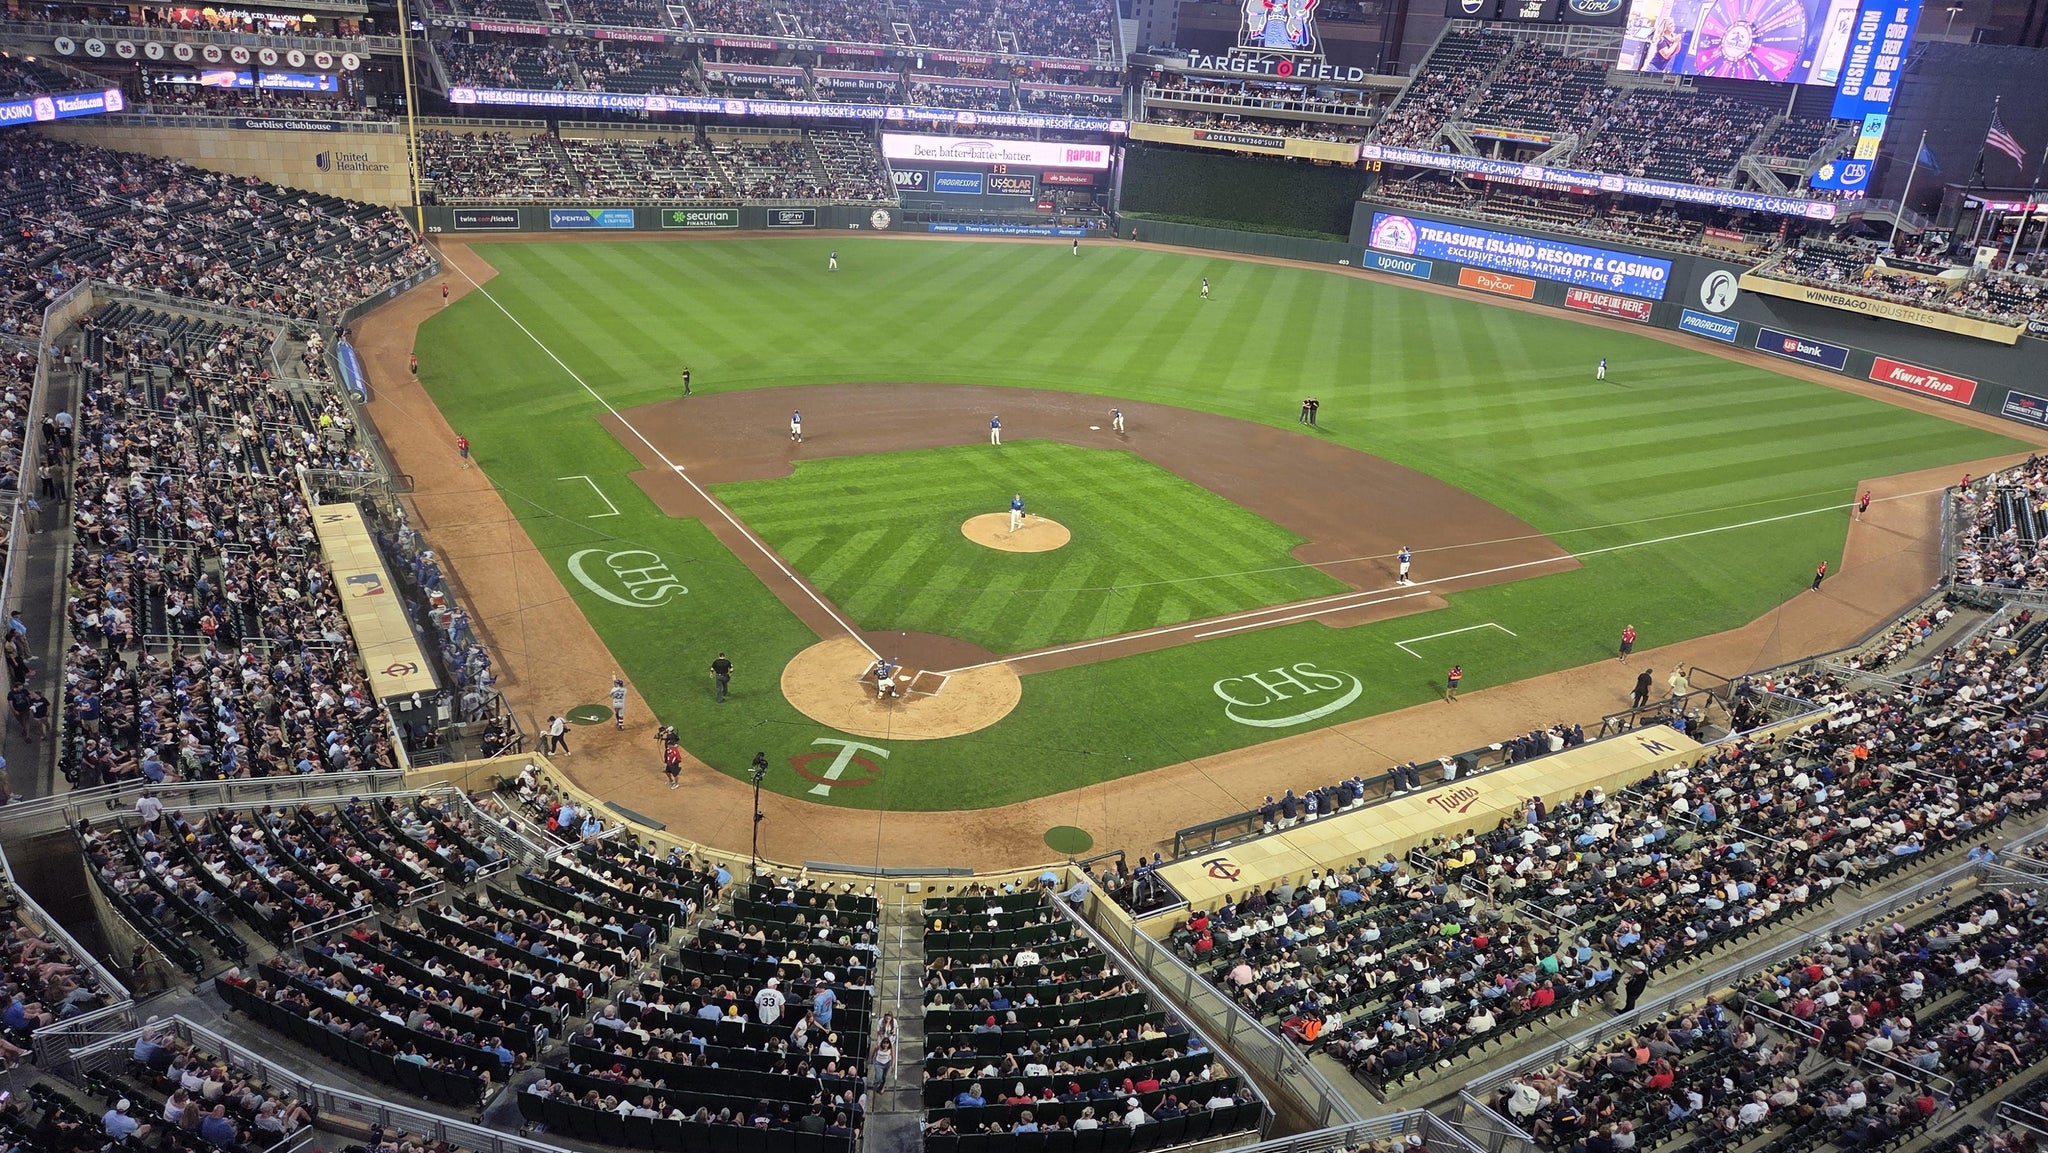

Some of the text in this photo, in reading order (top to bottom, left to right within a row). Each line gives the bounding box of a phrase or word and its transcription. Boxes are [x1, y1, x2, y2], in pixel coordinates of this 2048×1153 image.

[1528, 2, 1542, 10] Star
[1520, 9, 1540, 18] Tribune
[480, 23, 540, 34] Treasure Island
[90, 44, 101, 53] 42
[120, 45, 132, 54] 36
[721, 39, 771, 49] Treasure Island
[151, 47, 158, 55] 7
[179, 48, 188, 56] 10
[235, 51, 246, 60] 34
[264, 52, 274, 61] 14
[1842, 10, 1883, 95] CHSINC.COM
[293, 54, 299, 62] 6
[348, 58, 354, 66] 3
[939, 54, 966, 63] Treasure
[1188, 54, 1364, 82] TARGET FIELD
[728, 74, 767, 84] Treasure
[833, 79, 857, 88] Home
[859, 81, 874, 89] Run
[476, 92, 644, 107] TREASURE ISLAND RESORT & CASINO
[1092, 95, 1113, 104] Deck
[750, 102, 884, 118] TREASURE ISLAND RESORT & CASINO
[246, 120, 331, 130] Carbliss Clubhouse
[977, 114, 1016, 126] TREASURE
[1017, 117, 1045, 127] ISLAND
[1046, 118, 1073, 128] RESORT
[1080, 121, 1108, 129] CASINO
[914, 144, 937, 156] Beer,
[335, 152, 368, 162] United
[1383, 150, 1421, 162] TREASURE
[1422, 154, 1451, 166] ISLAND
[1451, 158, 1481, 170] RESORT
[1489, 163, 1522, 175] CASINO
[337, 162, 389, 171] Healthcare
[1844, 164, 1866, 177] CHS
[892, 172, 922, 185] OX 9
[937, 178, 980, 187] PROGRESSIVE
[1485, 175, 1571, 193] UNIVERSAL SPORTS AUCTIONS
[1626, 182, 1806, 214] TREASURE ISLAND RESORT & CASINO
[687, 212, 728, 220] securian
[1420, 227, 1485, 249] TREASURE
[1486, 238, 1535, 259] ISLAND
[1537, 247, 1592, 268] RESORT
[1593, 257, 1604, 271] &
[1607, 260, 1664, 281] CASINO
[1378, 256, 1416, 272] uponor
[1448, 247, 1608, 284] EXCLUSIVE CASINO PARTNER OF THE
[1477, 276, 1514, 290] Paycor
[1574, 290, 1583, 301] NO
[1583, 292, 1609, 306] PLACE
[1609, 296, 1621, 309] LIKE
[1622, 299, 1644, 313] HERE
[1806, 290, 1935, 324] WINNEBAGO INDUSTRIES
[1684, 316, 1735, 335] PROGRESSIVE
[1784, 341, 1821, 357] us bank
[606, 550, 689, 600] CHS
[1213, 662, 1342, 707] CHS
[1427, 787, 1479, 814] Twins
[762, 998, 775, 1007] 33
